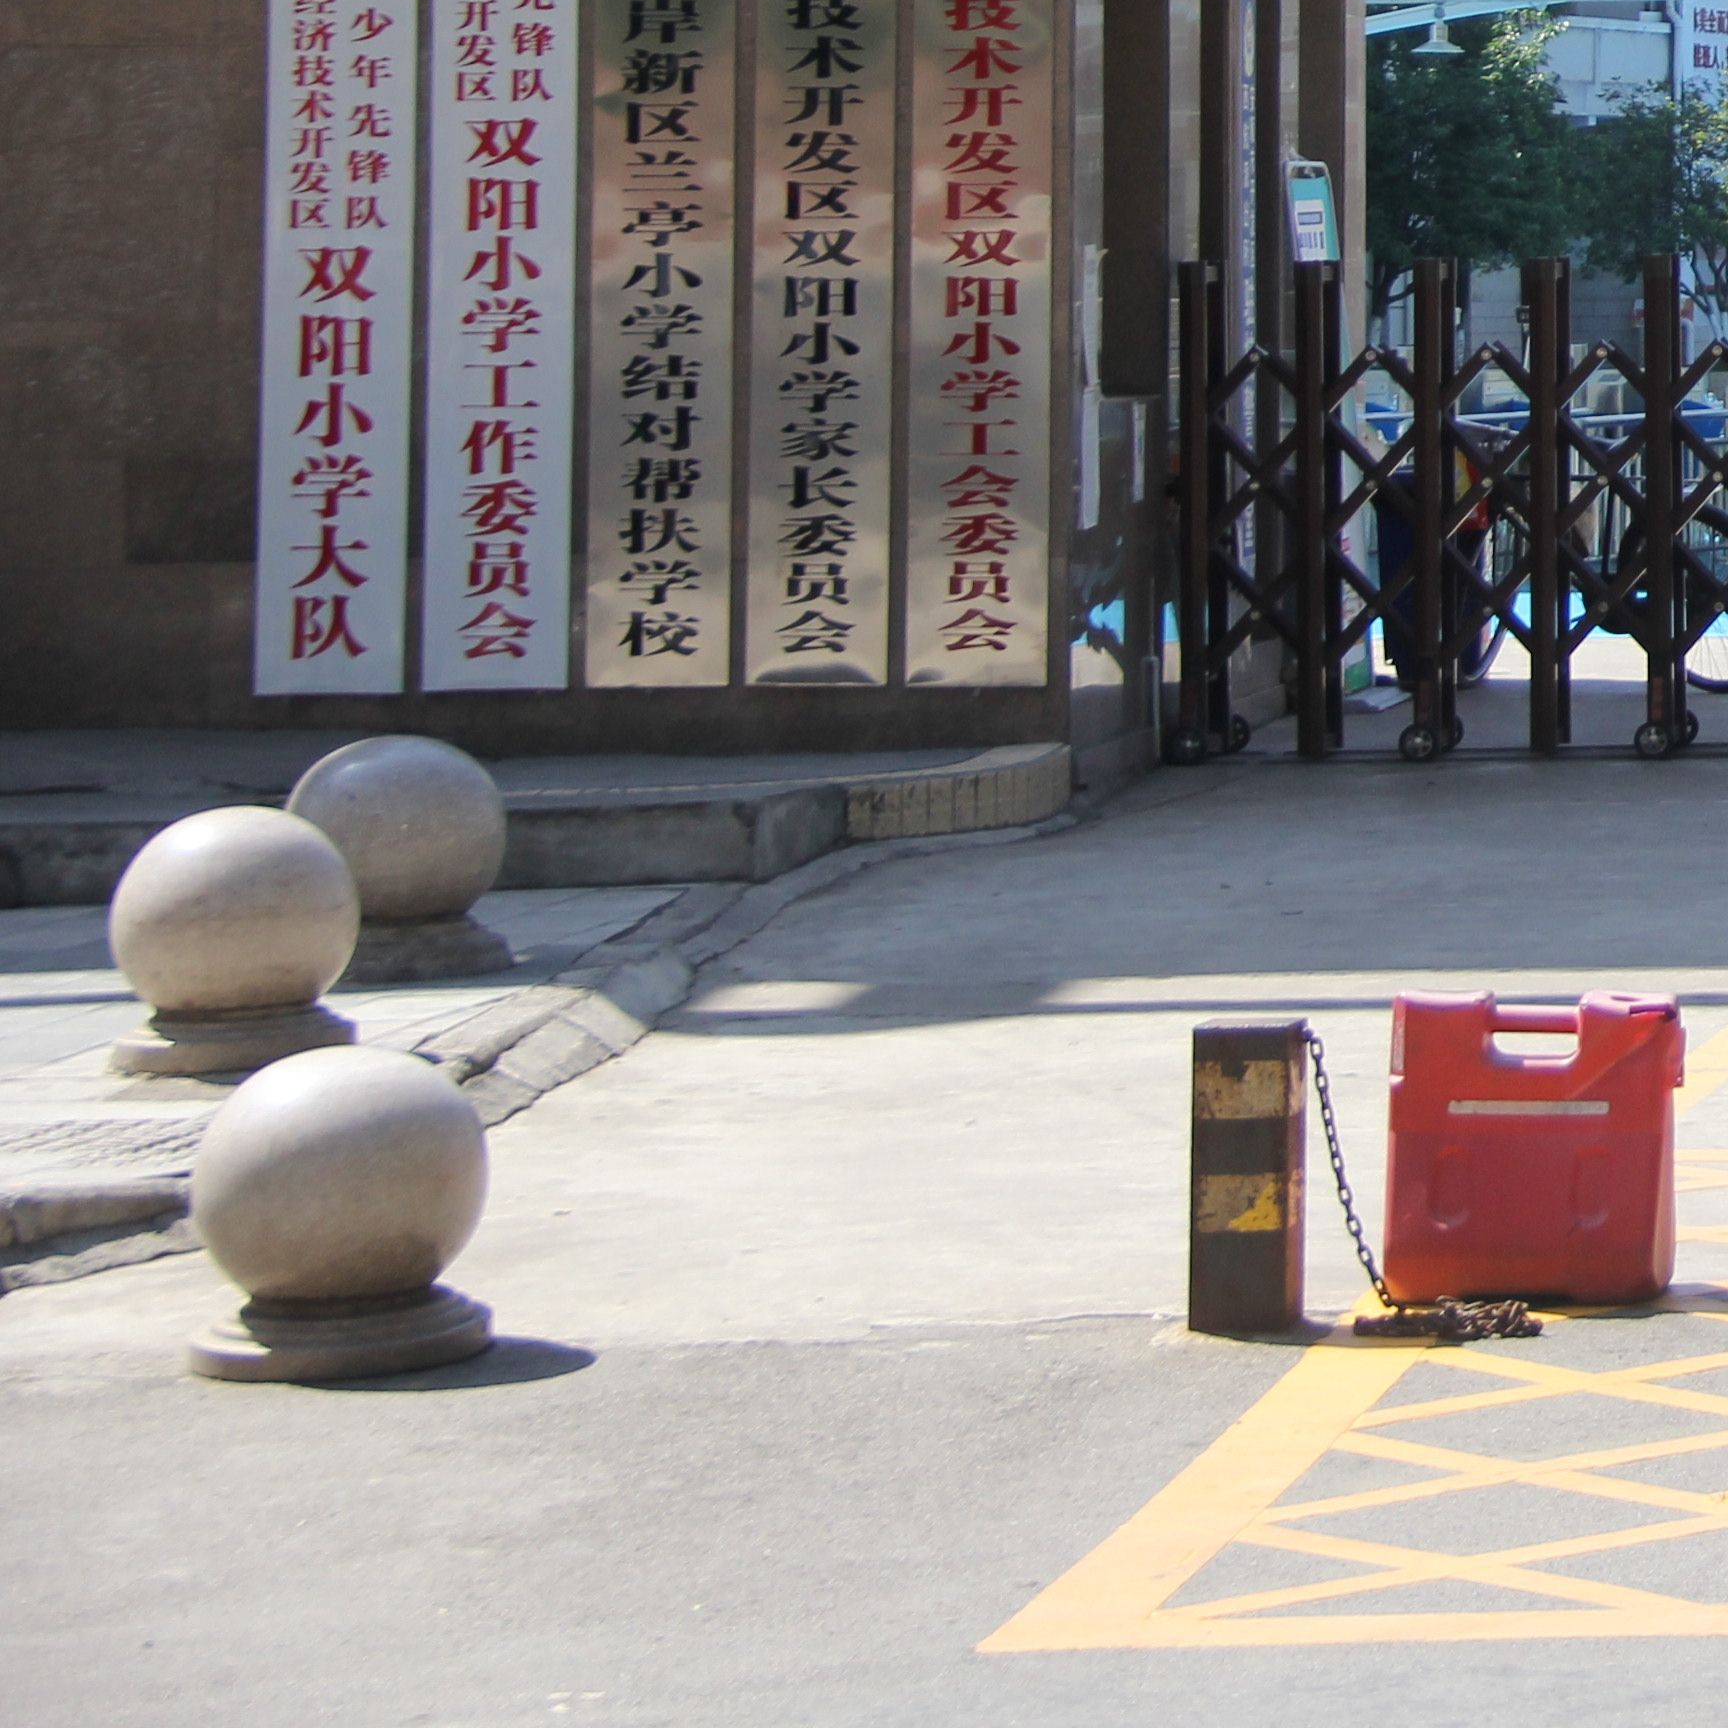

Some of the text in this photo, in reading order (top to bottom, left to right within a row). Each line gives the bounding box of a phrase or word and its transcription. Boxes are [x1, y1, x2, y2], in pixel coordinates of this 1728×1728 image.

[289, 245, 378, 659] 双阳小学大队
[457, 118, 543, 659] 双阳小学工作委员会
